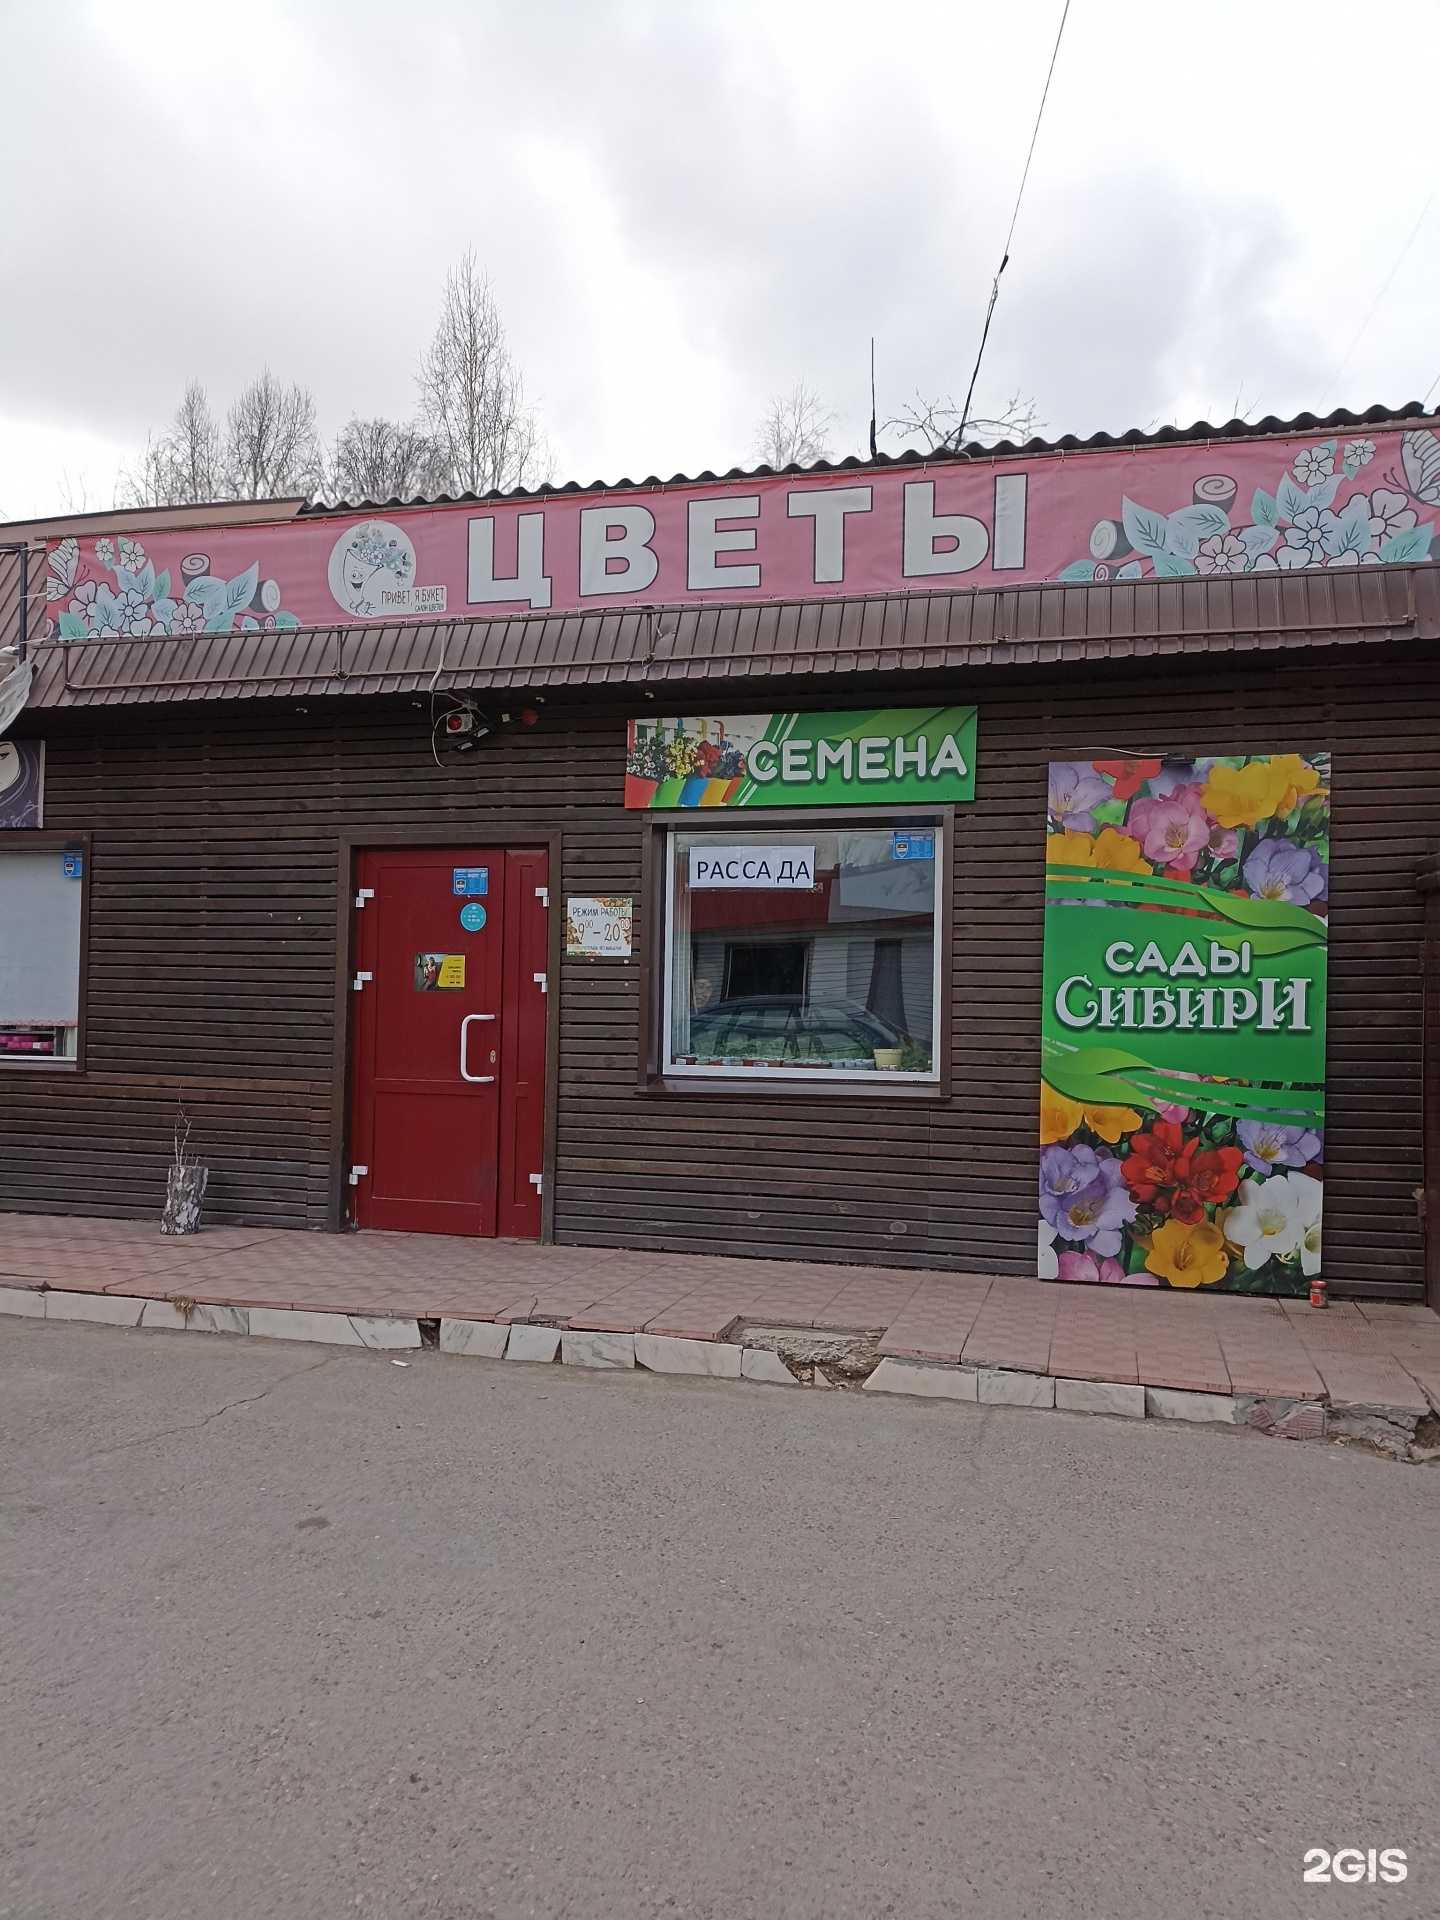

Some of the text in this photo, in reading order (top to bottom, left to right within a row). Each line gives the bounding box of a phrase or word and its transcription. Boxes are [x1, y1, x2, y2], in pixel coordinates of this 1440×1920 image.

[467, 472, 1028, 610] ЦВЕТЫ
[381, 588, 444, 606] ПРИВЕТ, Я БУКЕТ
[747, 734, 968, 782] СЕМЕНА
[572, 906, 628, 918] РЕЖИМ РАБОТЫ
[1105, 941, 1251, 976] САДЫ
